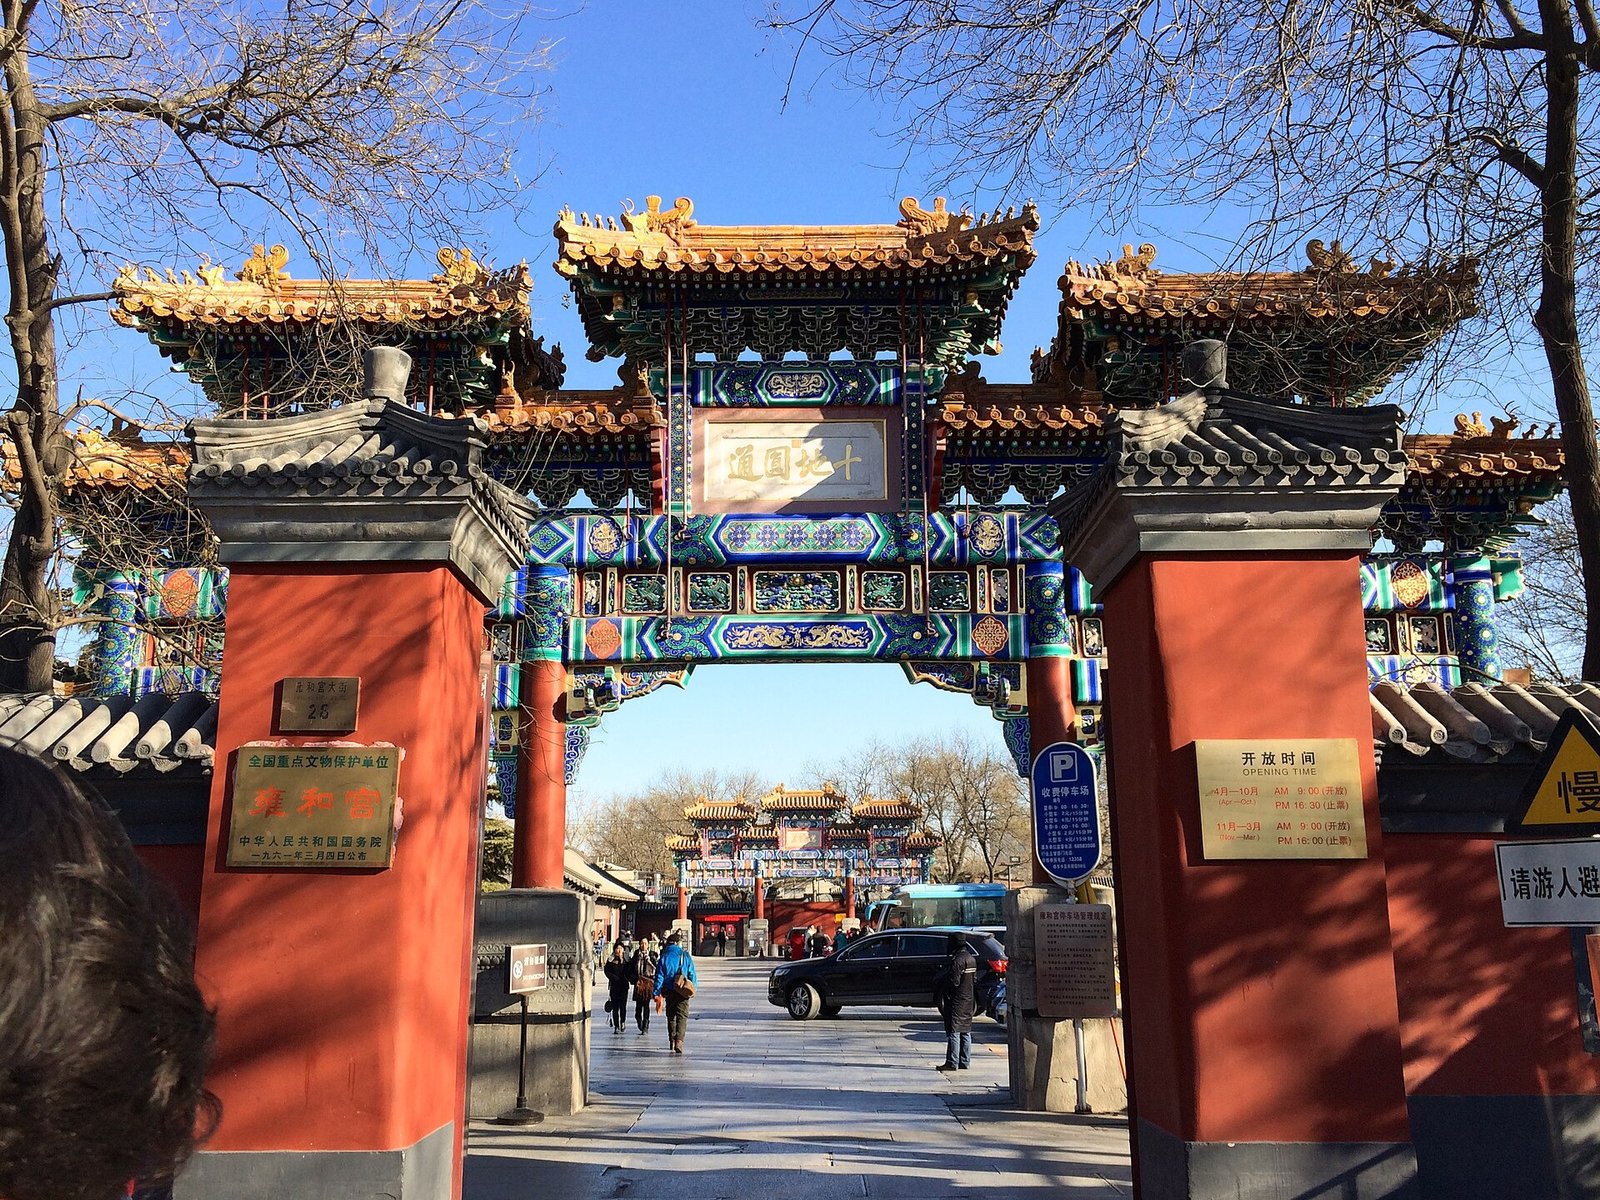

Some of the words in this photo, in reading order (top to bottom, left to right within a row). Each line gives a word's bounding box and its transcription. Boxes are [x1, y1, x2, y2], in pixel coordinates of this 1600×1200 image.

[249, 755, 389, 769] 全国重点文物保护单位
[1241, 751, 1316, 766] 开放时间
[1053, 754, 1074, 779] P
[1242, 768, 1289, 776] OPENING
[1292, 768, 1318, 776] TIME
[1041, 785, 1089, 797] 收费停车场
[1274, 787, 1289, 796] AM
[1557, 771, 1600, 814] 慢
[248, 785, 381, 820] 雍和宫
[1275, 801, 1290, 810] PM
[1276, 822, 1292, 831] AM
[239, 836, 382, 848] 中华人民共和国国务院
[1277, 836, 1293, 845] PM
[251, 850, 368, 861] 一九六一年三月四日公布
[1511, 866, 1600, 900] 请游人避
